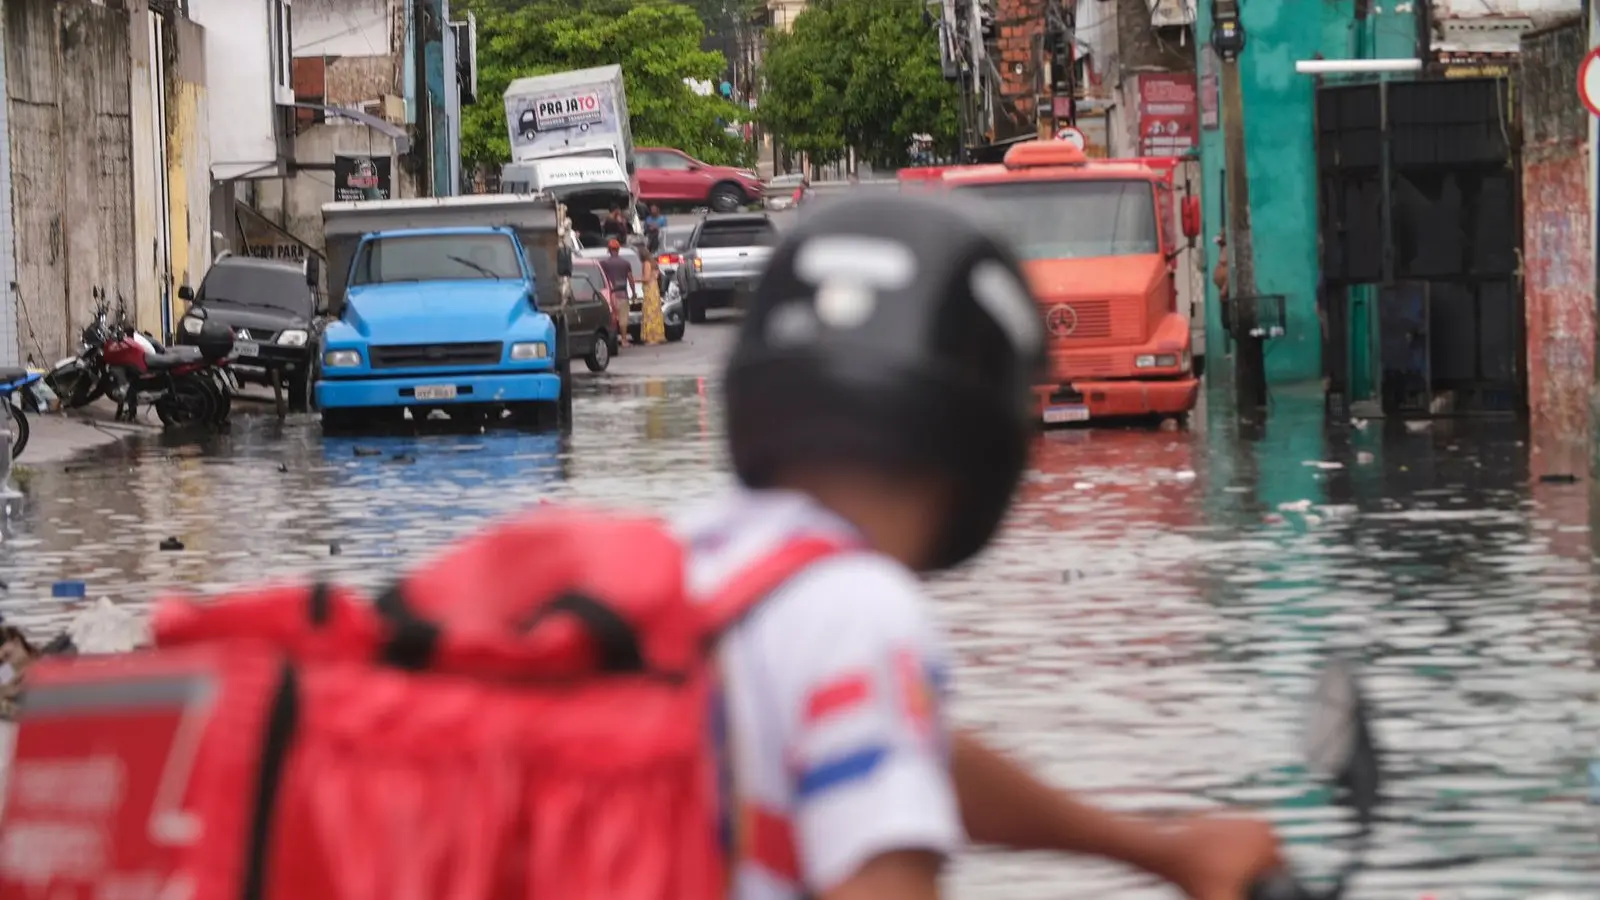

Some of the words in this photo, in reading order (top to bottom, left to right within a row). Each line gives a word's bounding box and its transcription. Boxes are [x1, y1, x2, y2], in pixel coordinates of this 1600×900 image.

[539, 101, 563, 117] PRA
[566, 96, 595, 112] JATO
[278, 244, 304, 259] PARA
